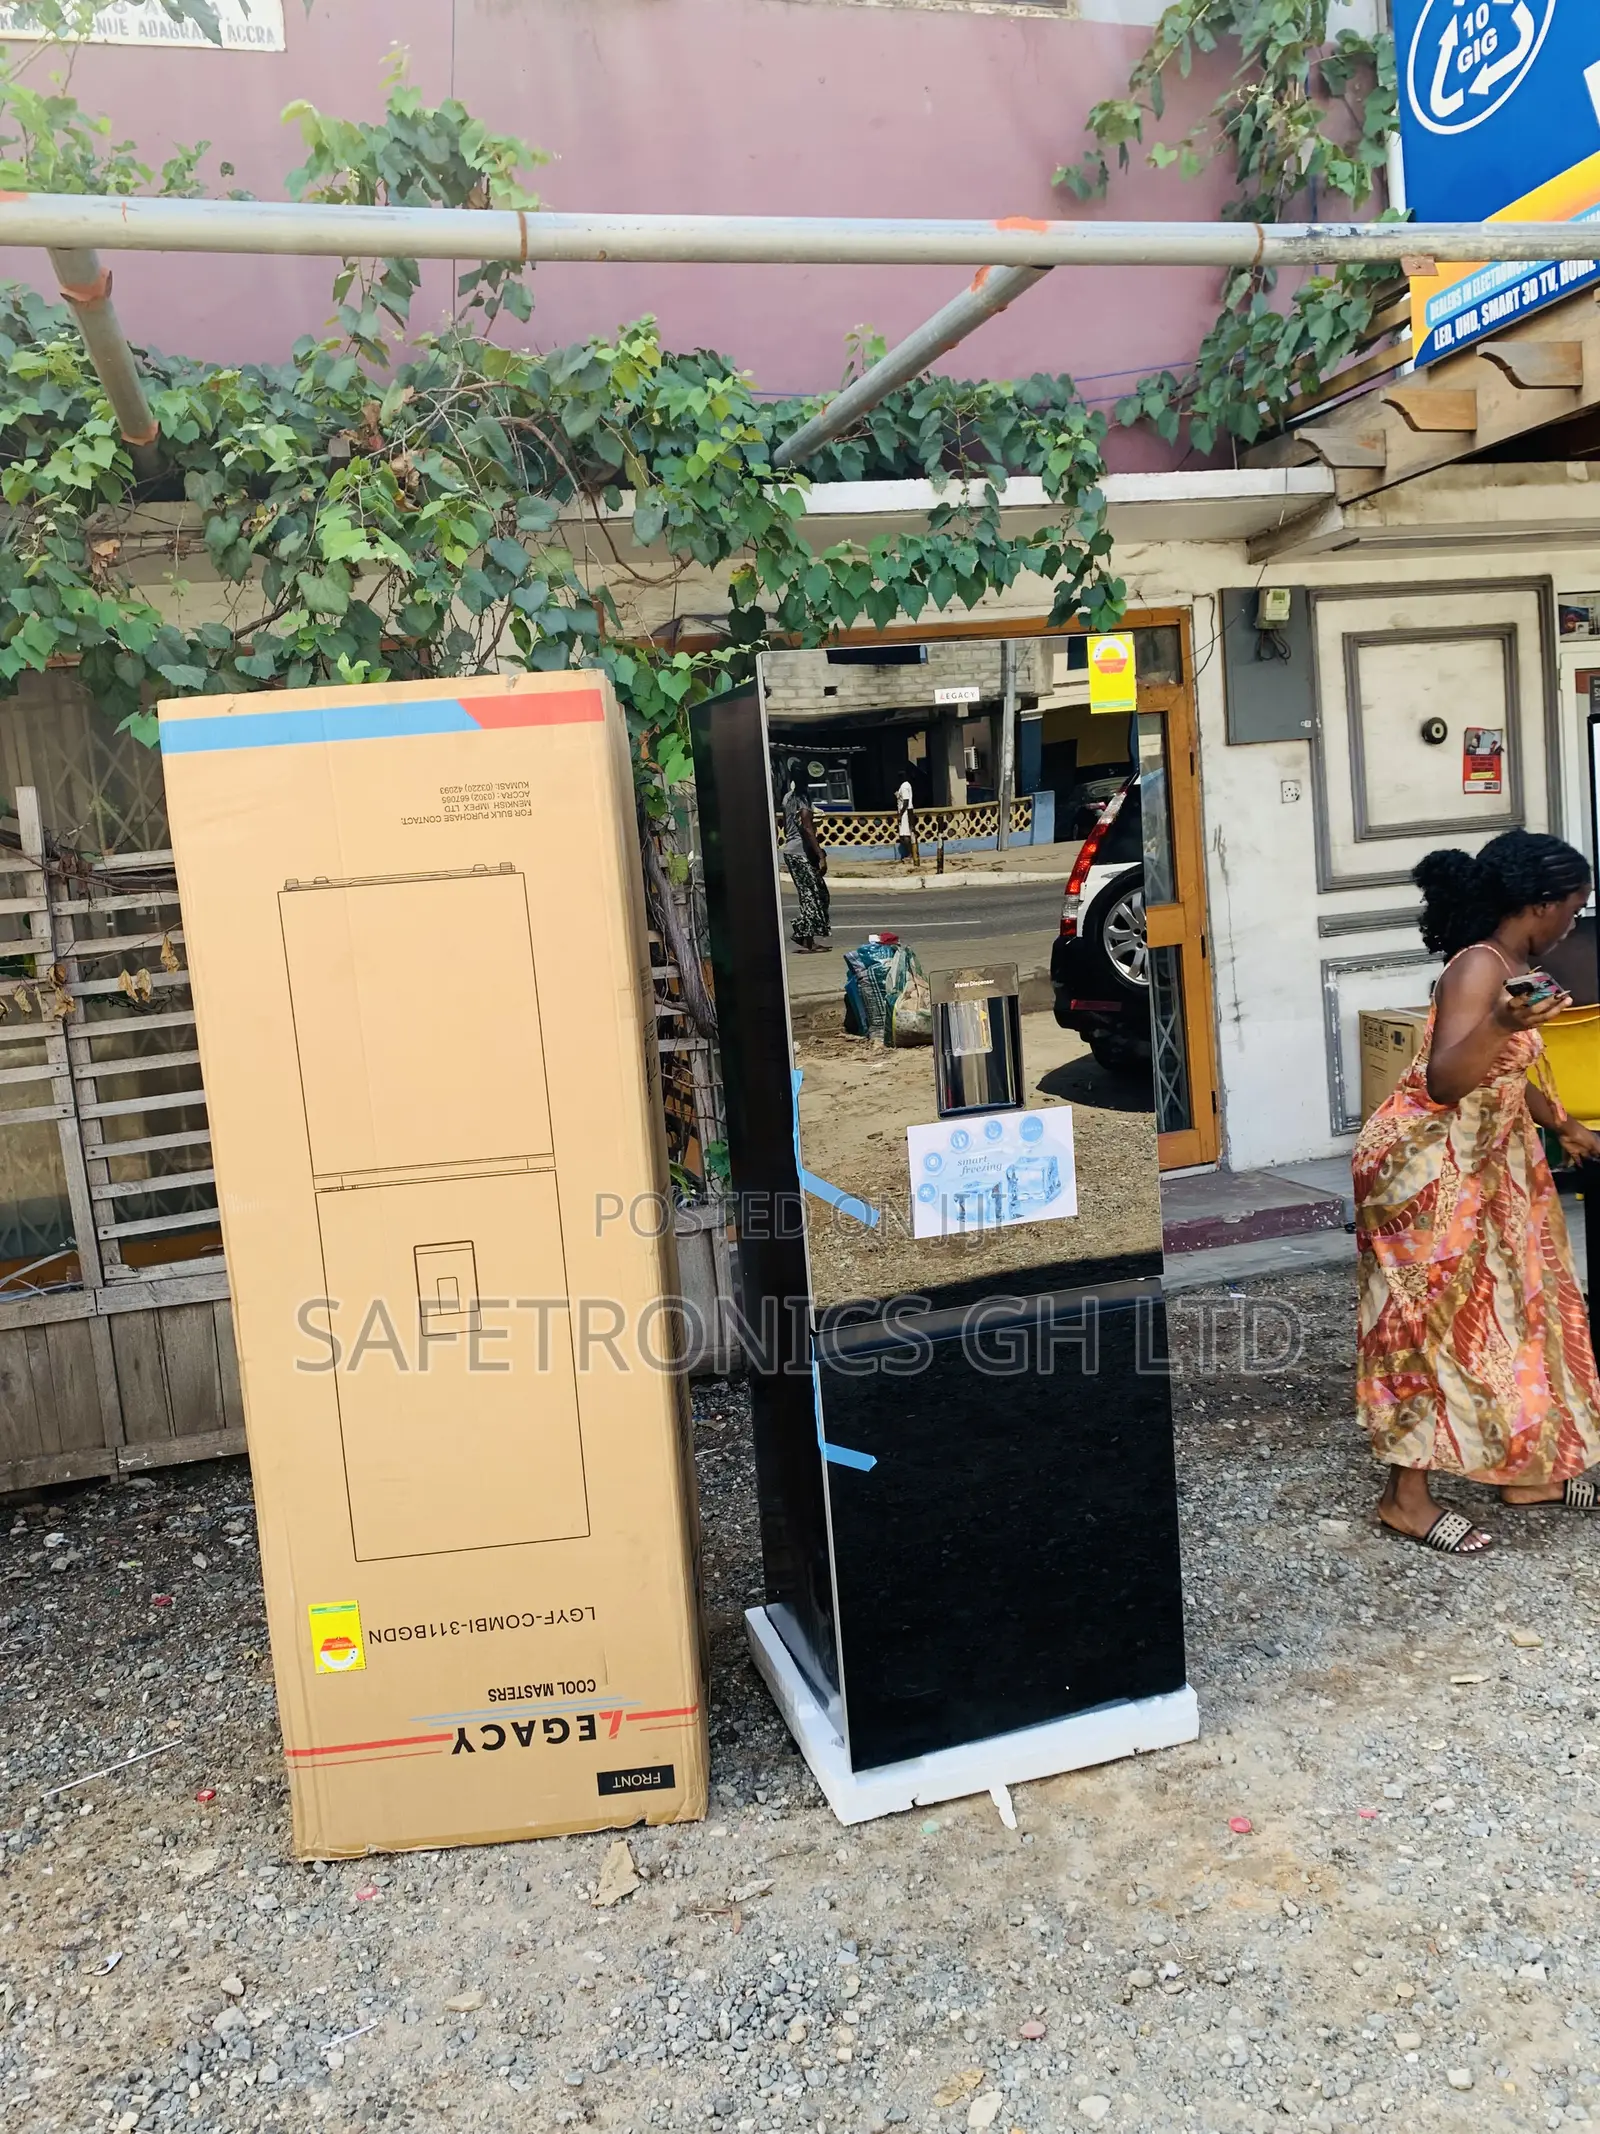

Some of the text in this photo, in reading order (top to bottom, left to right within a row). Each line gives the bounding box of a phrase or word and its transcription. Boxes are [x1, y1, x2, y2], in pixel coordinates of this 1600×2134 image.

[1463, 2, 1490, 38] 10
[226, 23, 277, 45] ACCRA
[1457, 27, 1498, 73] GIG
[1433, 323, 1456, 351] LED,
[1481, 285, 1521, 327] SMART
[1521, 277, 1540, 305] 3D
[1539, 265, 1559, 295] TV,
[940, 691, 976, 700] LEGACY
[465, 782, 494, 793] (03220)
[444, 799, 532, 813] MENKISH IMPEX LTD
[514, 809, 533, 817] FOR
[444, 811, 489, 823] PURCHASE
[491, 810, 513, 819] BULK
[957, 1155, 989, 1167] smart
[960, 1161, 1003, 1176] freezing
[368, 1605, 597, 1645] LGYF-COMBI-311BGDN
[488, 1679, 597, 1703] COOL MASTERS
[451, 1709, 624, 1755] LEGACY
[612, 1772, 662, 1789] FRONT
